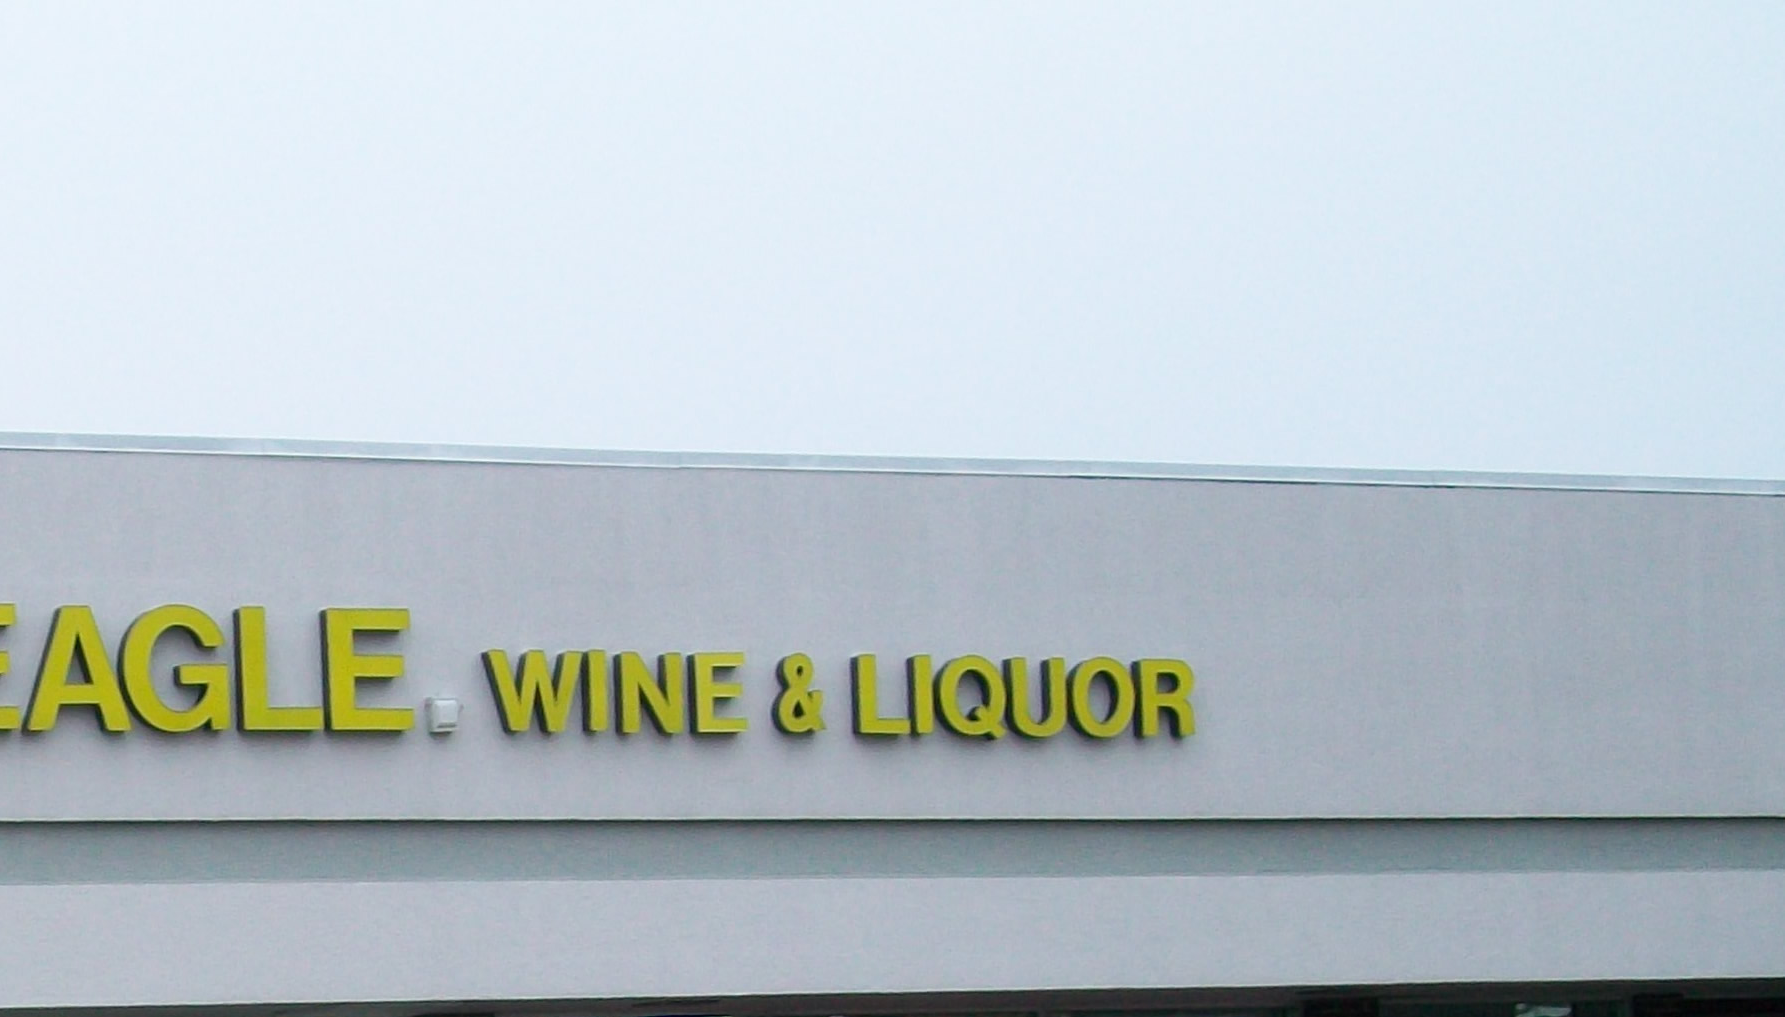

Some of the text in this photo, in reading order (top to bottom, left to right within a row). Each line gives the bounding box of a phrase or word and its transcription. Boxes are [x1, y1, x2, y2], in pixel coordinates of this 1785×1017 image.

[481, 648, 748, 734] WINE
[772, 652, 826, 734] &
[850, 653, 1197, 742] LIQUOR
